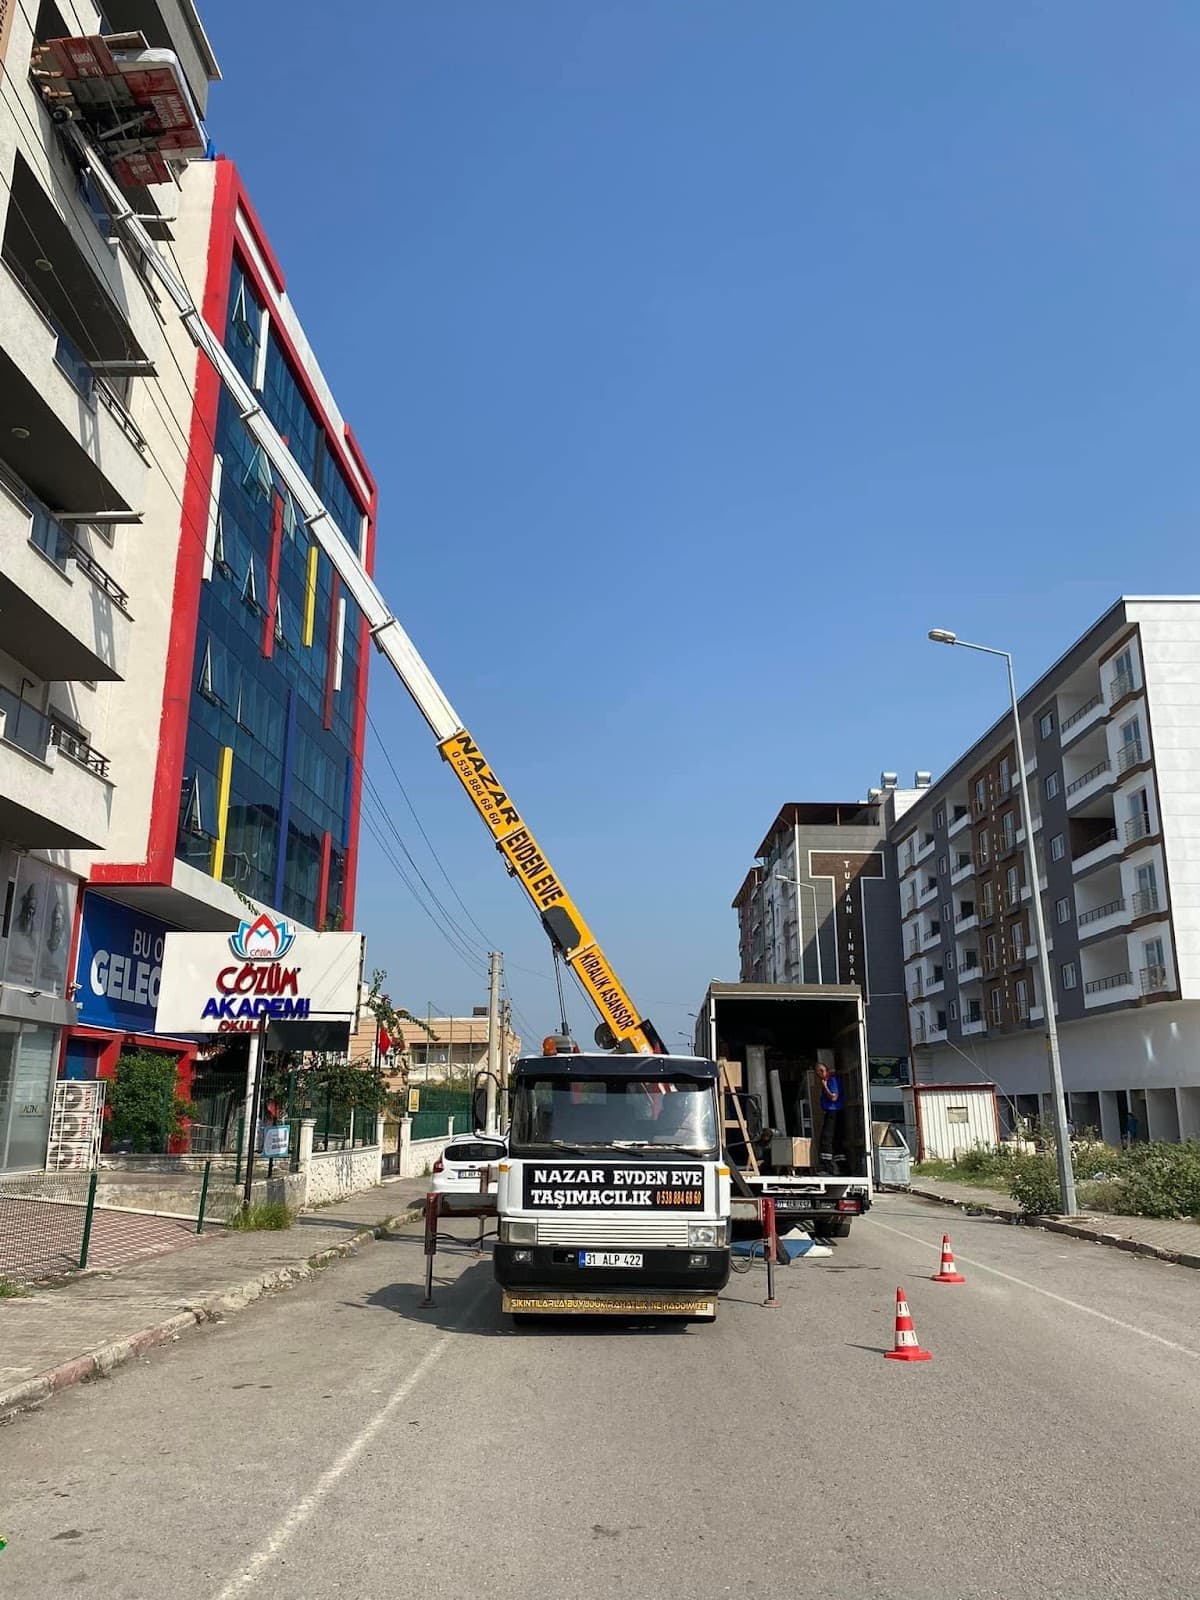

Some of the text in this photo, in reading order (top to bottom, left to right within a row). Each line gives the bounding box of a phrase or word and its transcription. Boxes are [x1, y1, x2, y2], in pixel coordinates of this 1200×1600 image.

[456, 735, 520, 825] NAZAR
[457, 759, 473, 777] 538
[469, 778, 484, 796] 884
[481, 798, 493, 811] 68
[489, 812, 500, 825] 60
[506, 830, 564, 907] EVDEN EVE
[843, 860, 852, 914] TUFAN
[133, 928, 152, 958] BU
[215, 962, 299, 997] ÇÖZÜM
[534, 1169, 703, 1186] NAZAR EVDEN EVE
[531, 1189, 702, 1209] TAŞIMACILIK 0 538 884 68 60
[586, 1254, 641, 1266] 31 ALP 422
